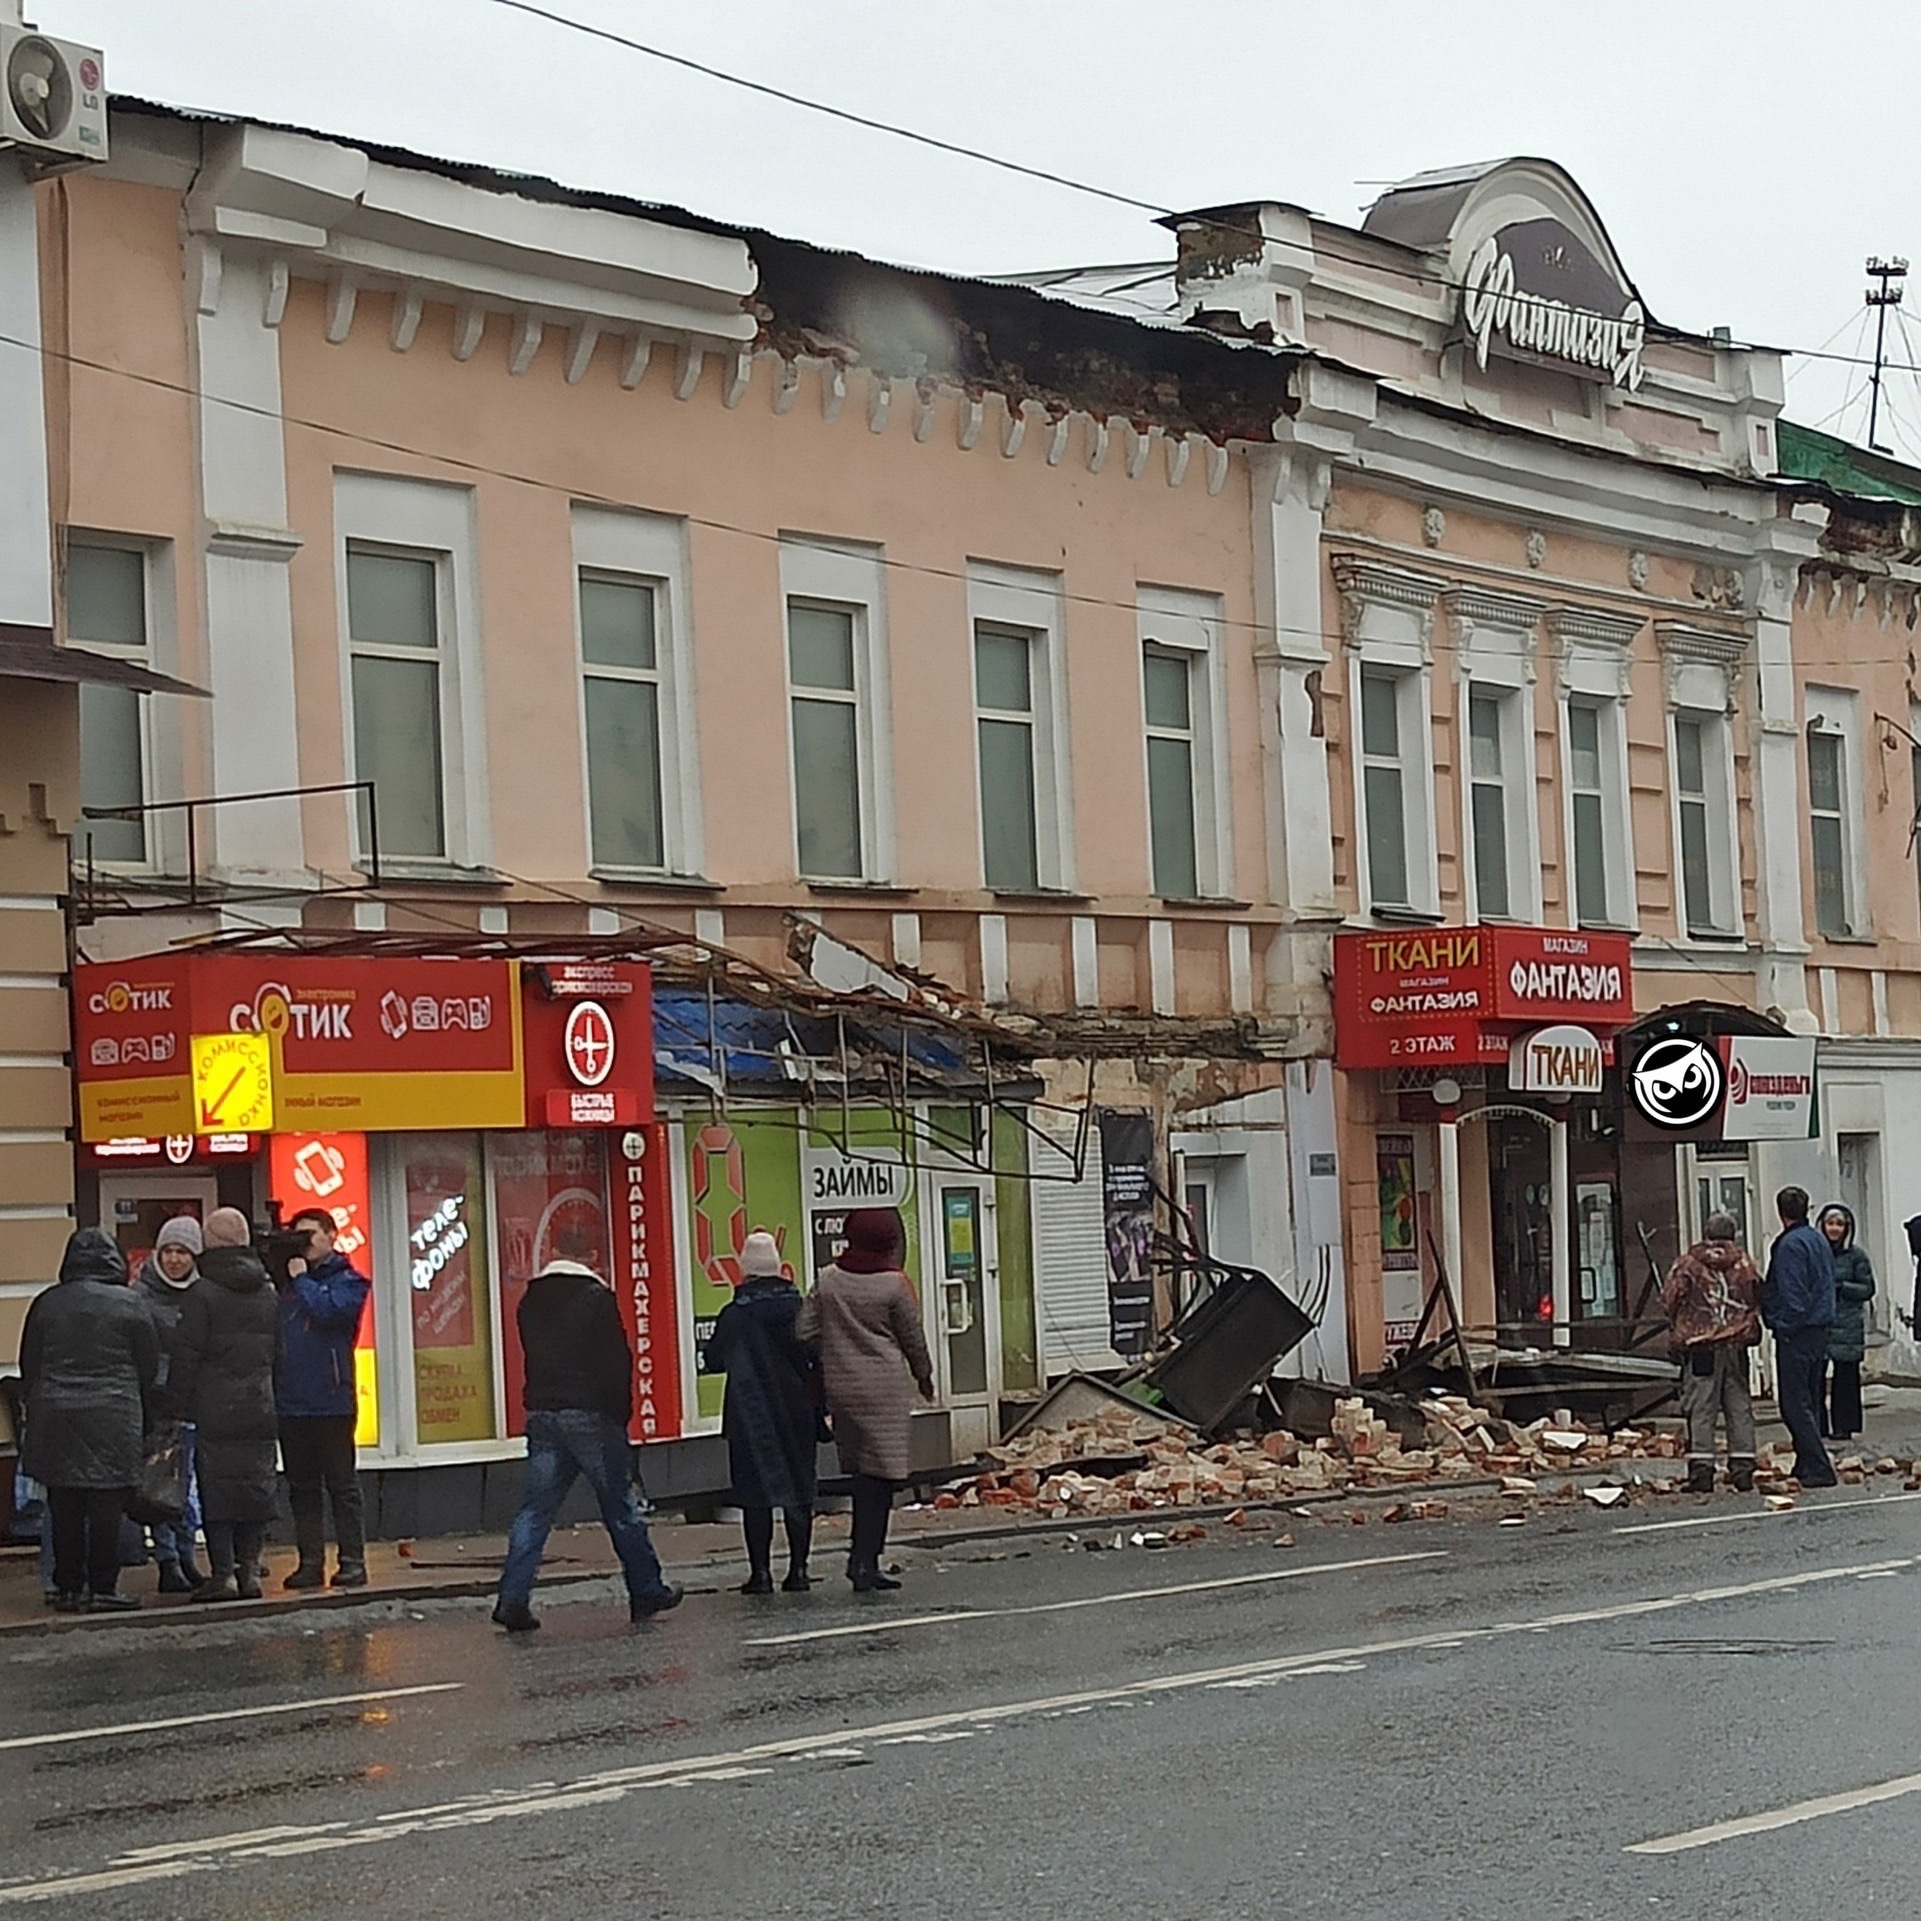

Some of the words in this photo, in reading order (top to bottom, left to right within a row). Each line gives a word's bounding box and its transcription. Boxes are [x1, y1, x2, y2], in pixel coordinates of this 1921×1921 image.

[1366, 936, 1479, 972] ТКАНИ
[1543, 936, 1588, 955] МАГАЗИН
[1399, 976, 1449, 988] МАГАЗИН
[1510, 961, 1622, 1001] ФАНТАЗИЯ
[1370, 990, 1479, 1013] ФАНТАЗИЯ
[1391, 1040, 1401, 1054] 2
[1405, 1035, 1456, 1053] ЭТАЖ
[1477, 1034, 1483, 1051] 2
[1484, 1035, 1509, 1051] ЭТАЖ
[1532, 1044, 1600, 1087] ТКАНИ
[813, 1157, 895, 1198] ЗАЙМЫ
[626, 1166, 657, 1433] ПАРИКМАХЕРСКАЯ
